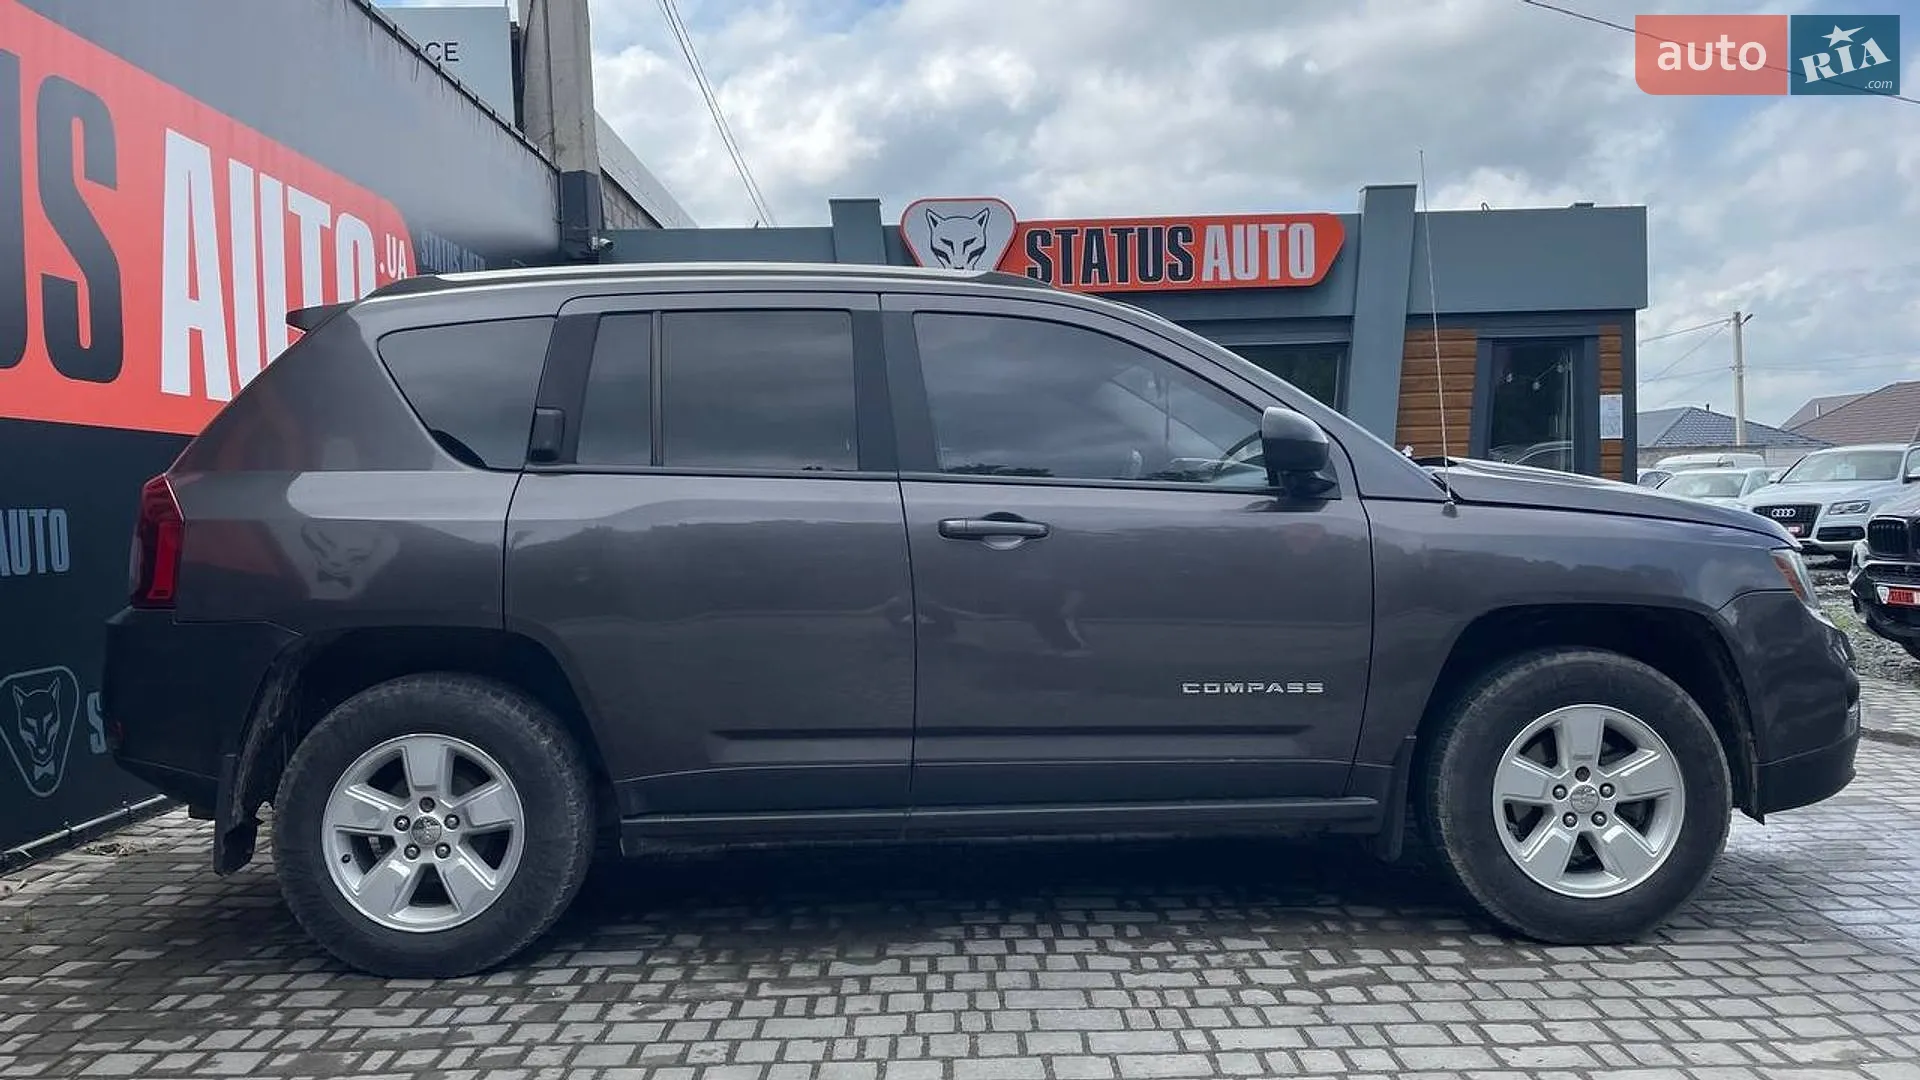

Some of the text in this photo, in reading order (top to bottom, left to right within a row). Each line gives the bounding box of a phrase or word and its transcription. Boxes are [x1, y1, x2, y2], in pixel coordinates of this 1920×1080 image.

[0, 49, 123, 384] S
[1025, 223, 1315, 286] STATUS AUTO
[1182, 682, 1324, 693] COMPASS
